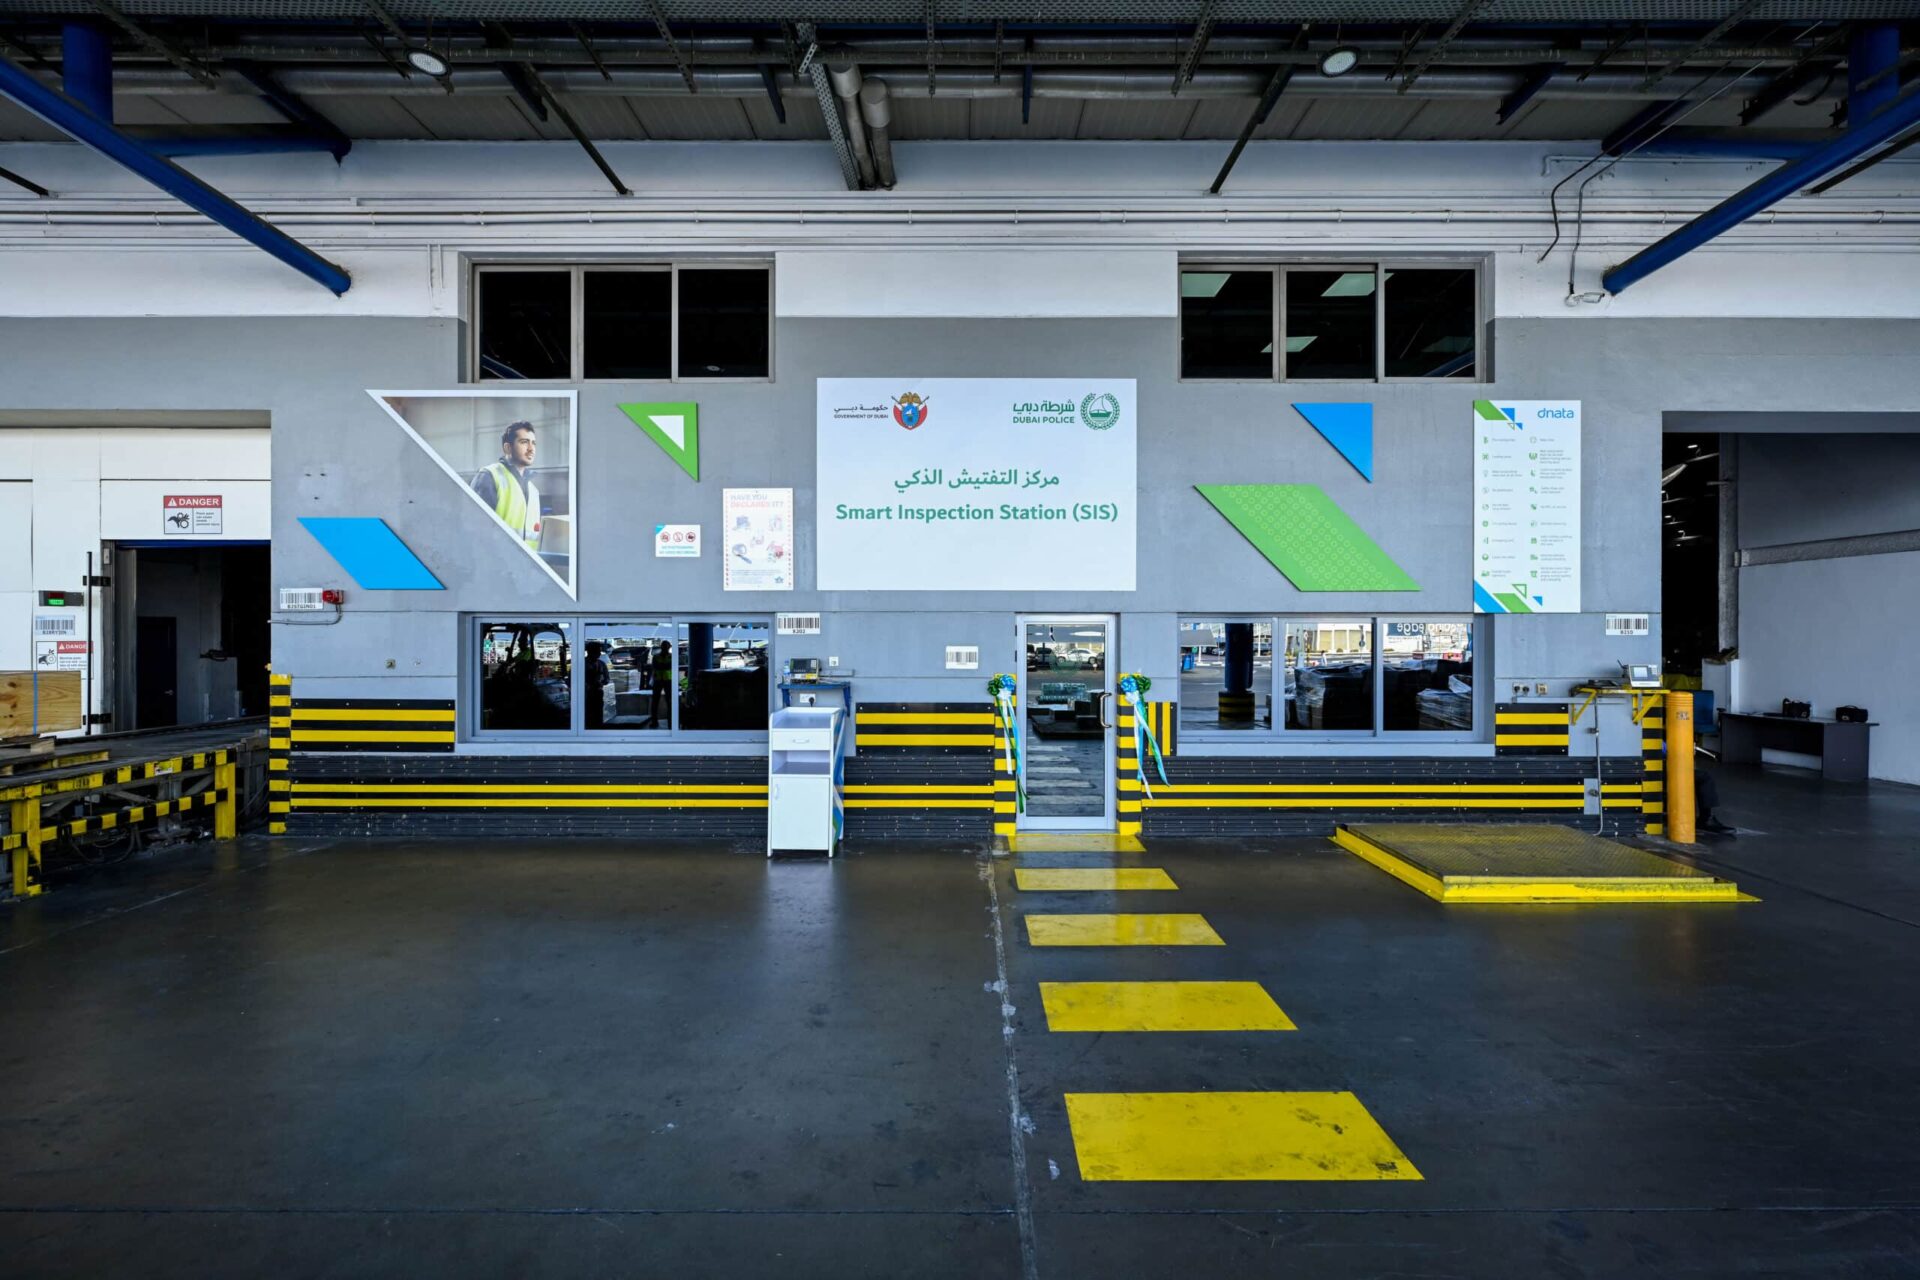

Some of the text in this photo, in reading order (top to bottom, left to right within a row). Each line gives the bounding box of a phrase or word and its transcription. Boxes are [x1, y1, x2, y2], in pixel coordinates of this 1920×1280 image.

[1013, 399, 1075, 415] شرطة دبي
[1537, 407, 1575, 419] dnata
[1012, 416, 1075, 424] DUBAI POLICE
[894, 467, 1060, 493] مركز التفتيش الذكي
[178, 498, 220, 506] DANGER
[835, 502, 1119, 524] Smart Inspection Station (SIS)
